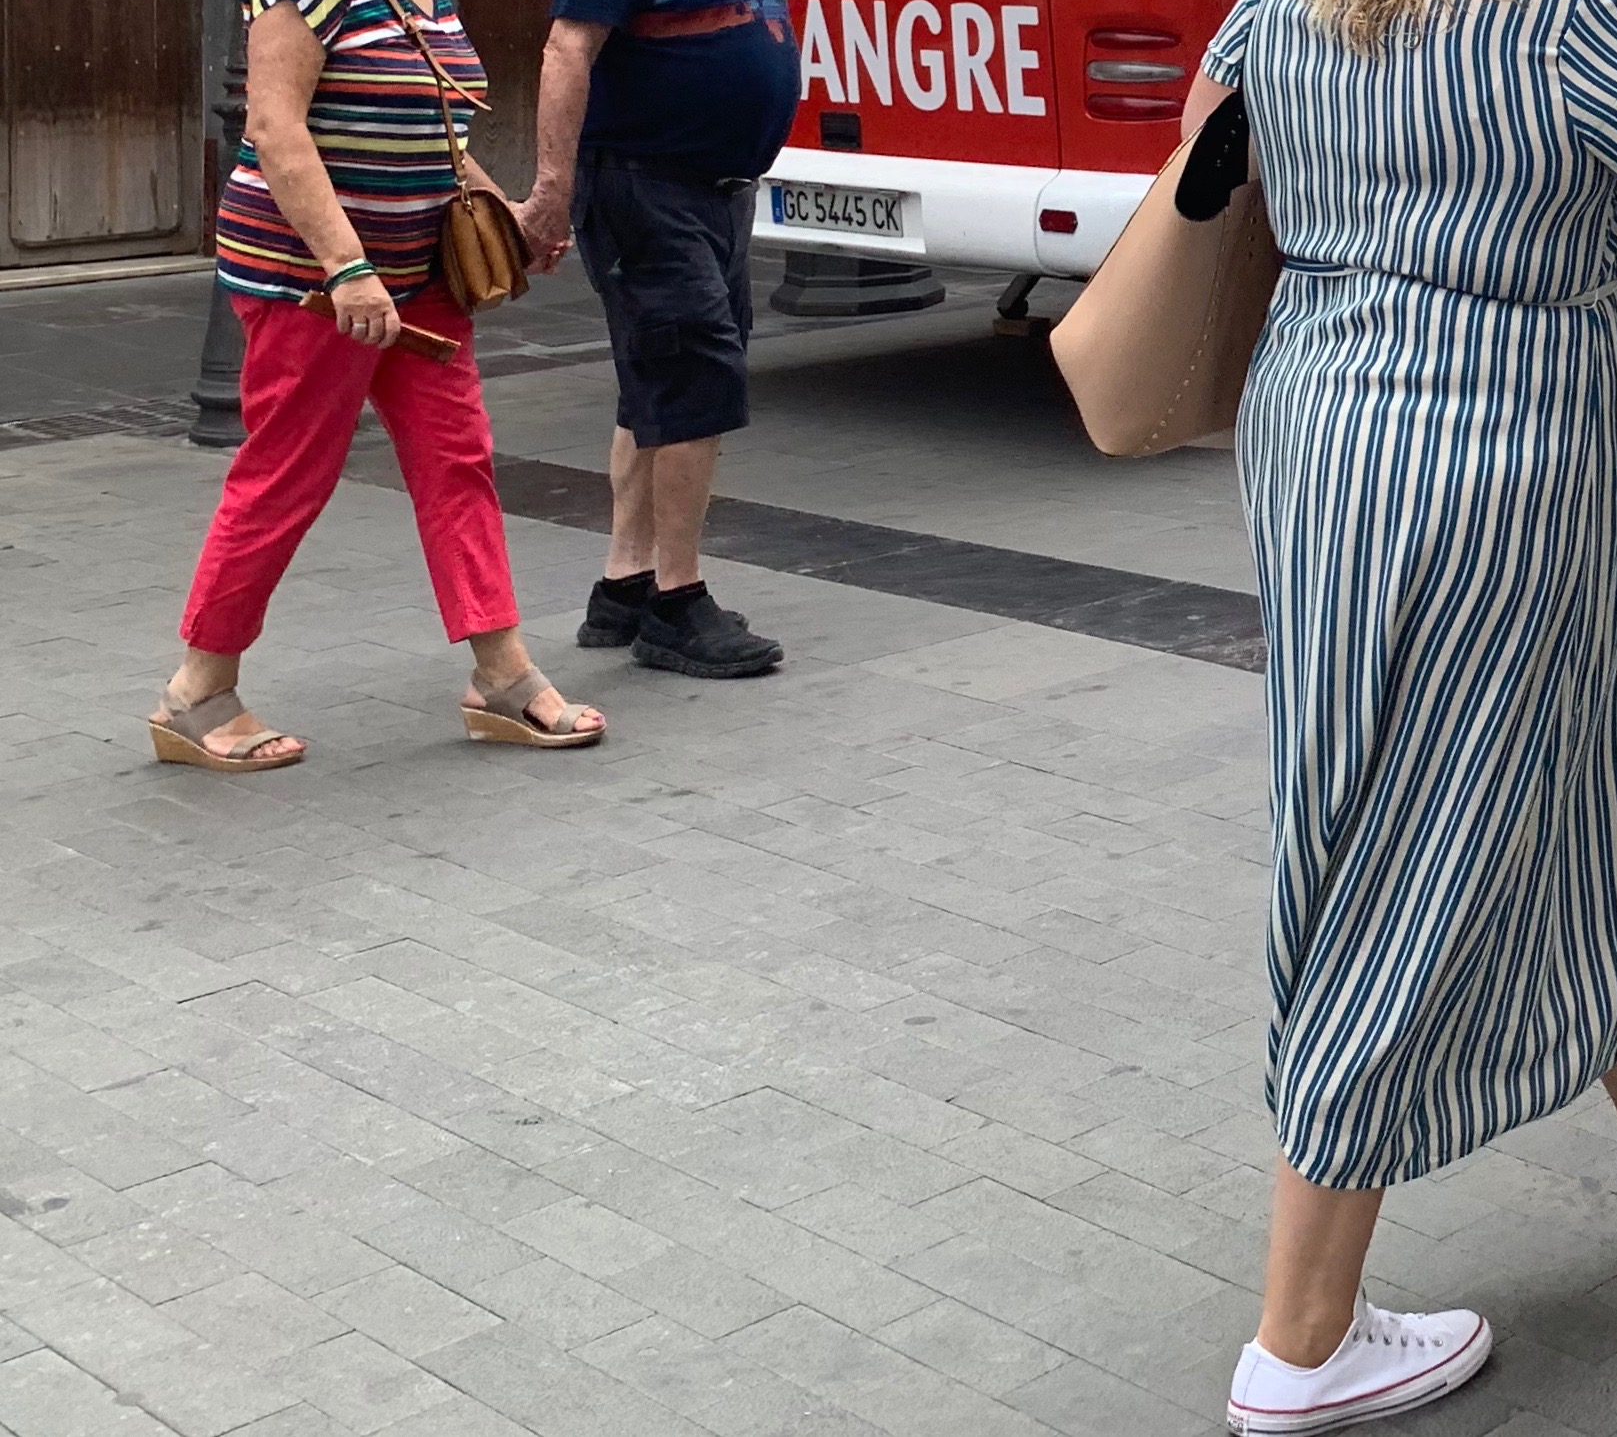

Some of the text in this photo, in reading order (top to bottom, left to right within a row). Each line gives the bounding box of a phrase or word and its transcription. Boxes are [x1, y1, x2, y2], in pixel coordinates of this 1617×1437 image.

[783, 190, 899, 231] GC 5445 CK
